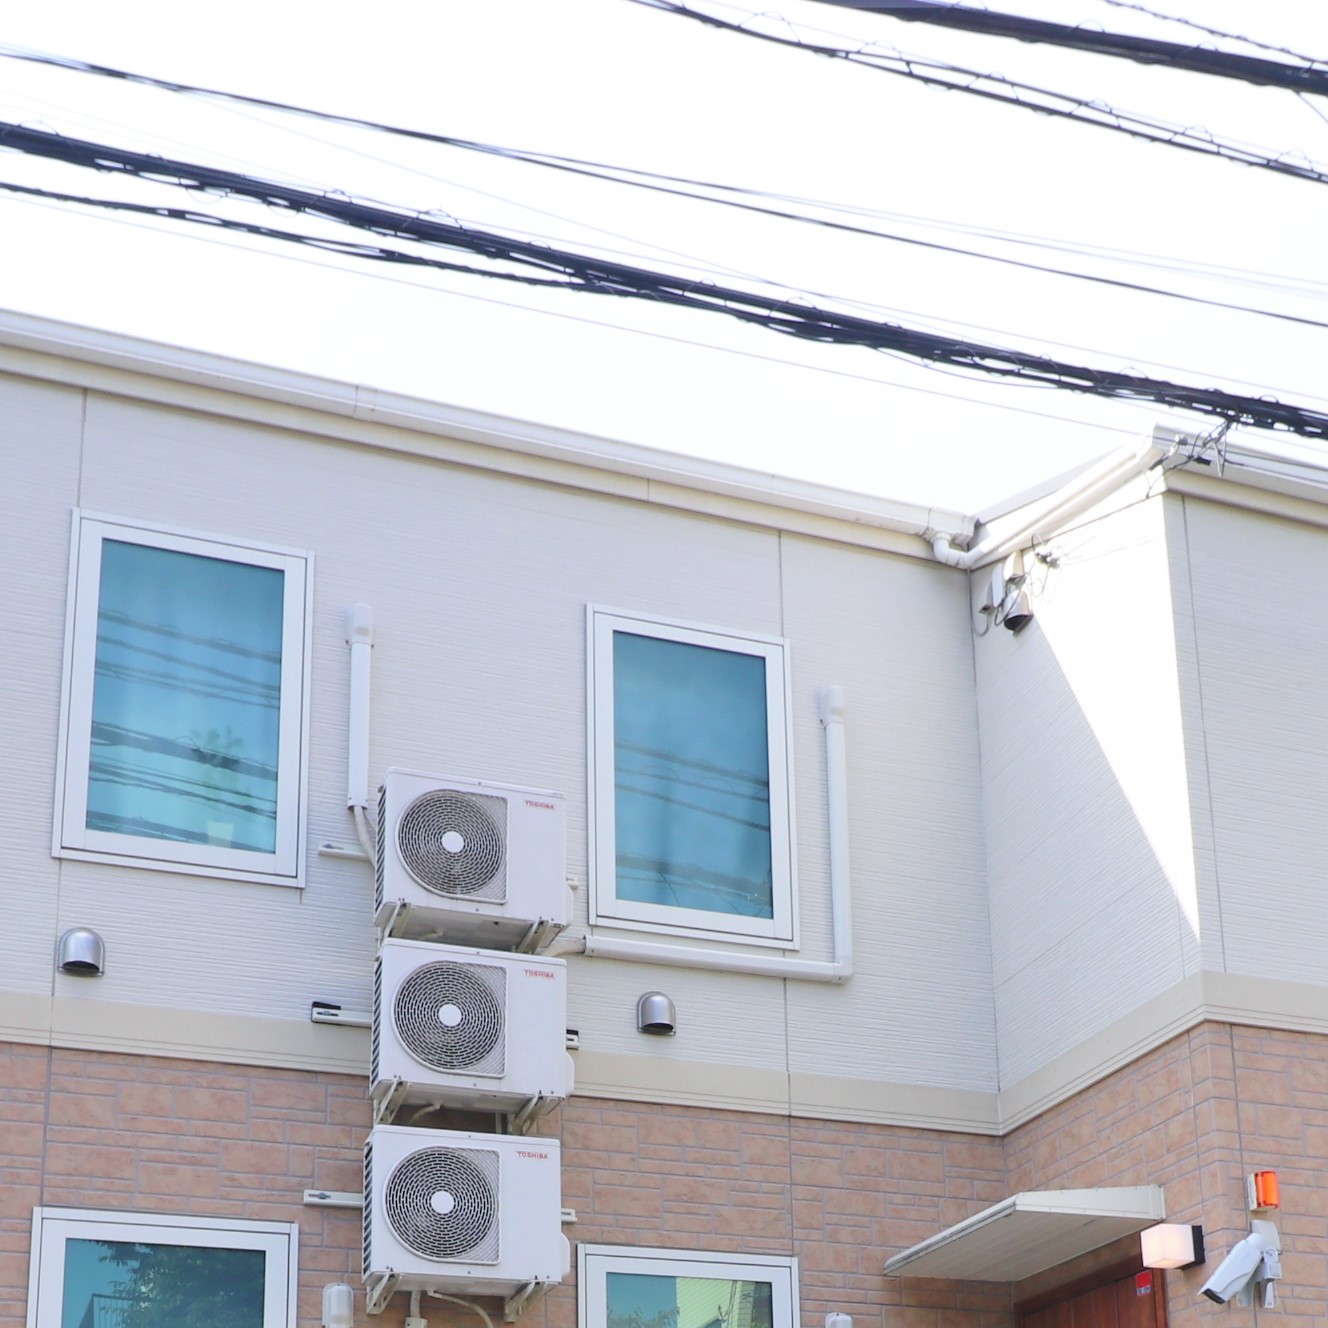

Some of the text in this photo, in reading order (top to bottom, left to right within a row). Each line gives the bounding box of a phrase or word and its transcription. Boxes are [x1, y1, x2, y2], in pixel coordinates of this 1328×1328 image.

[524, 799, 555, 810] TOSHIBA
[524, 969, 555, 979] TOSHIBA
[516, 1150, 549, 1160] TOSHIBA
